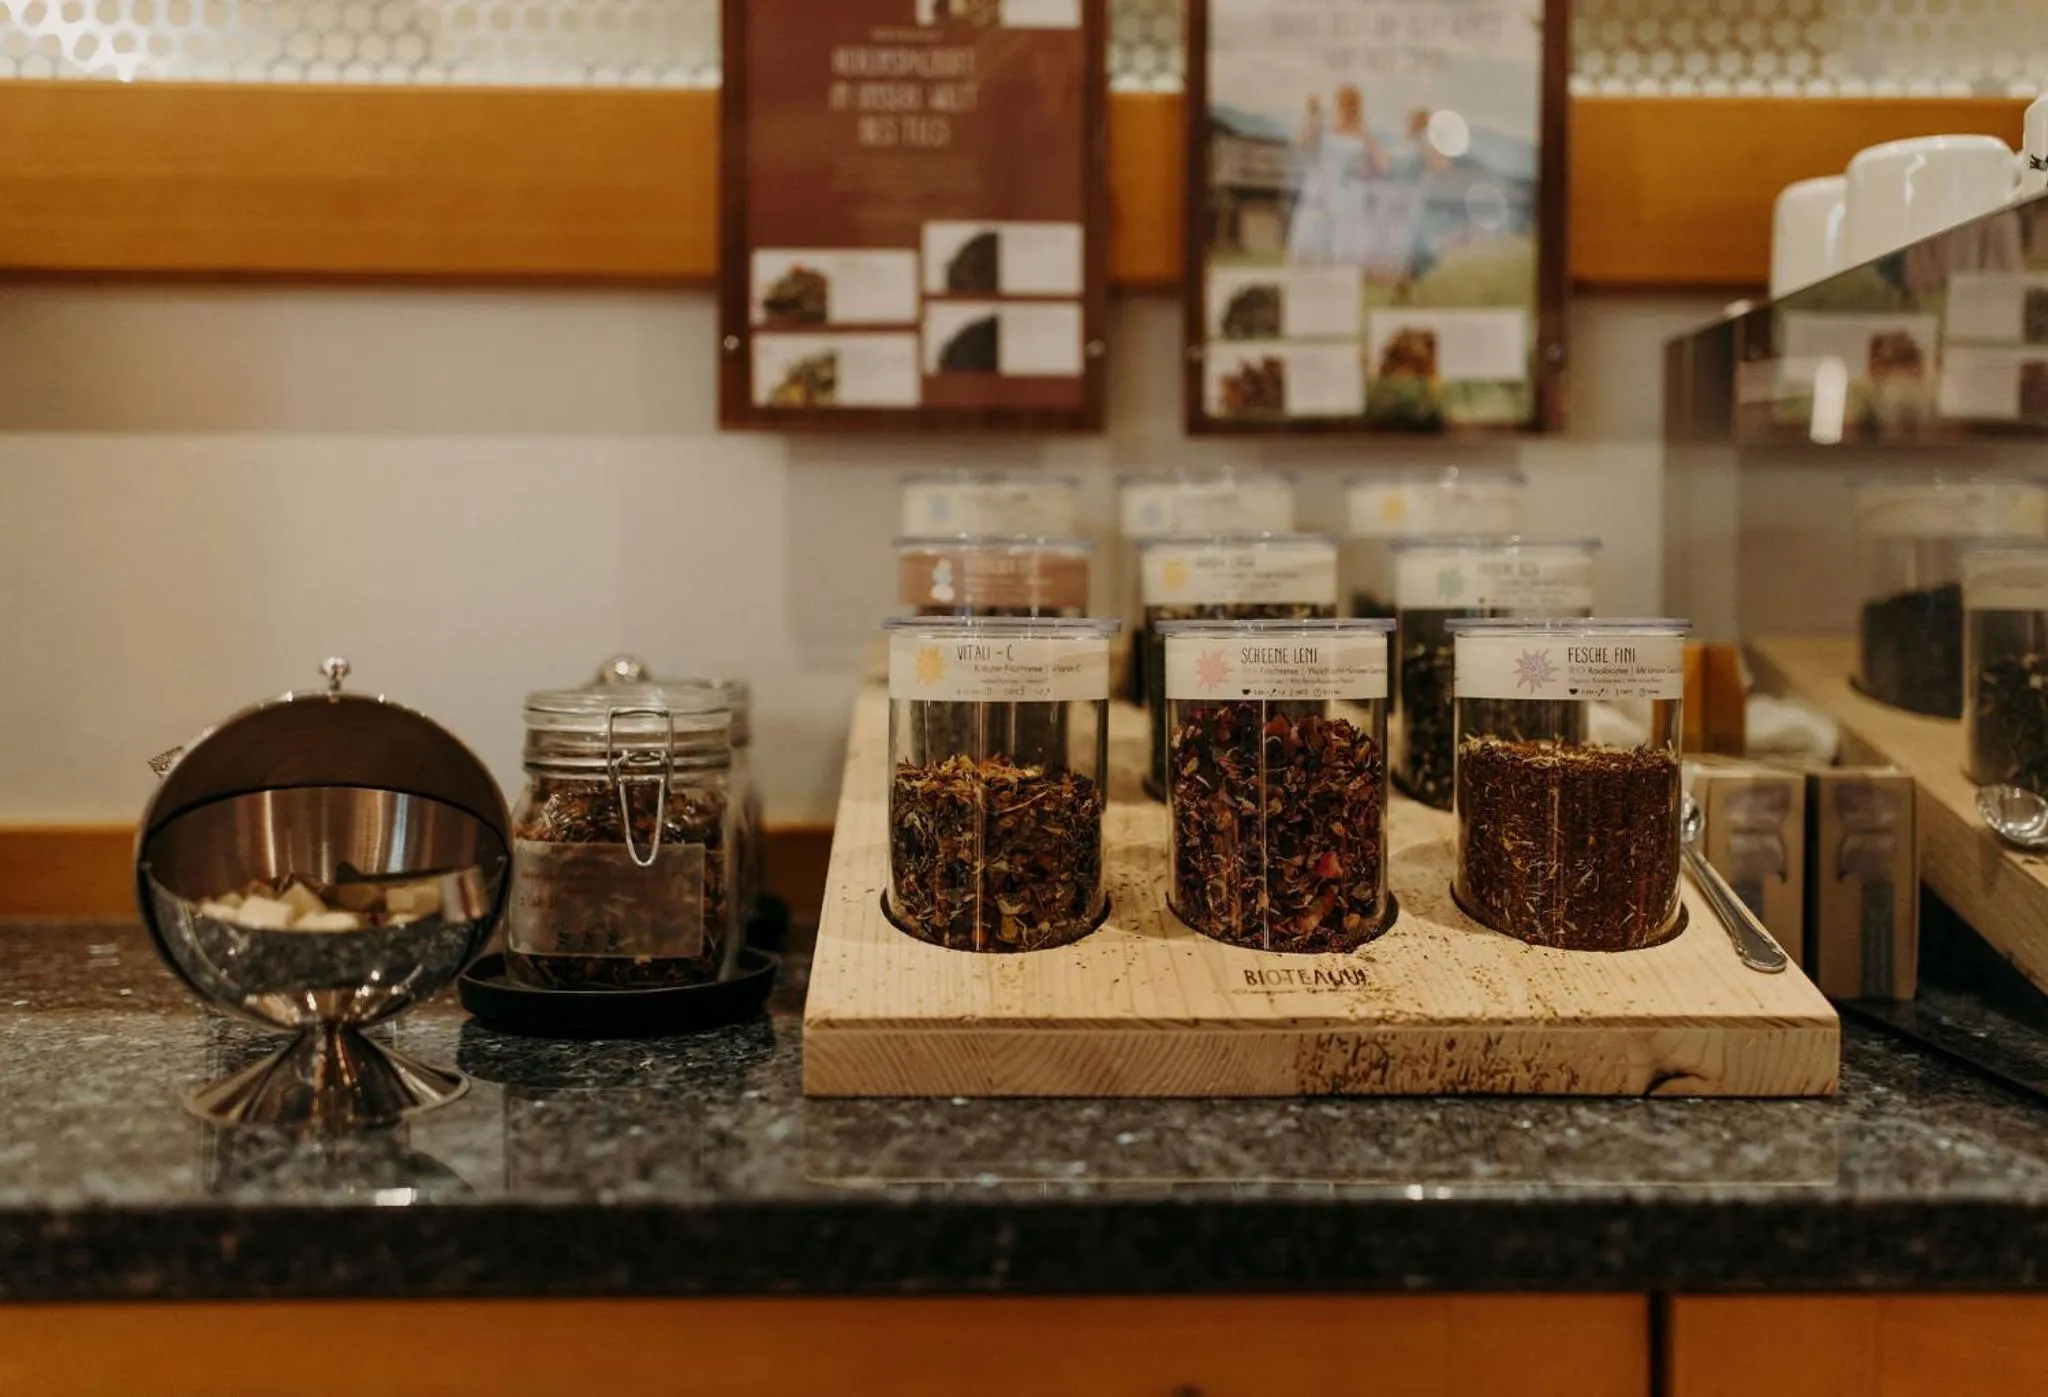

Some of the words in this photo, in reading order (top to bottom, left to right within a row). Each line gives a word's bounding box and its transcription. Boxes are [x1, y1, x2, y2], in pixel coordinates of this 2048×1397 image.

[957, 644, 991, 661] VITALI
[1006, 644, 1014, 661] C
[1240, 647, 1289, 664] SCHEENE
[1293, 647, 1318, 664] LENI
[1568, 647, 1609, 663] FESCHE
[1614, 647, 1636, 663] FINI
